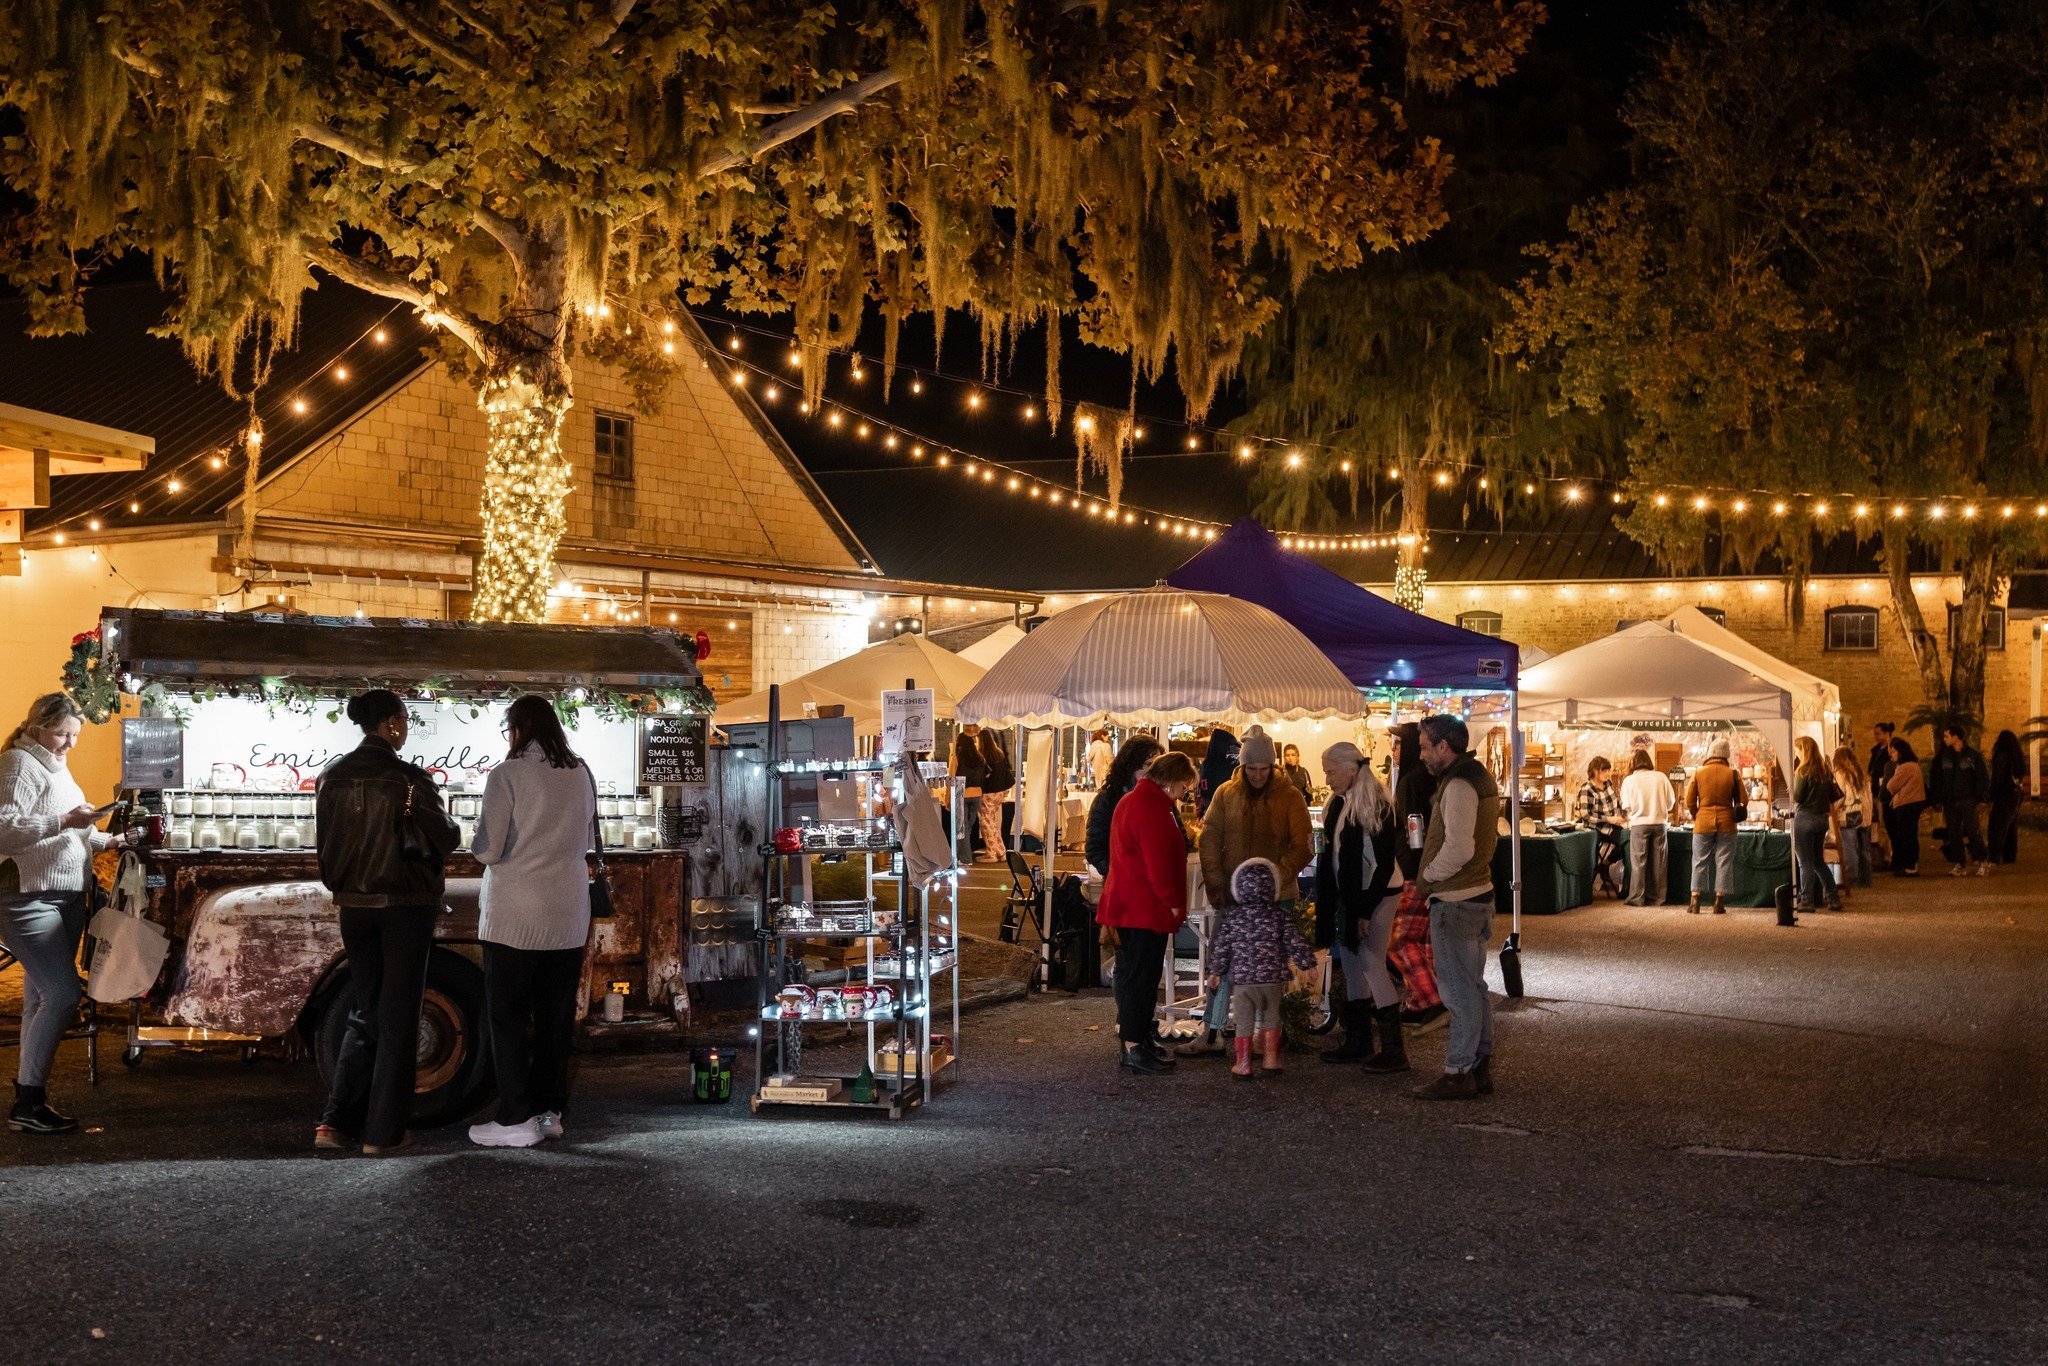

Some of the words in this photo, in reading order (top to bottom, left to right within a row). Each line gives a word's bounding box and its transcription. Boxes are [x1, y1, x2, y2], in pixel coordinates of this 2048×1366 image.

[887, 697, 929, 706] FRESHIES
[669, 719, 701, 727] GRN
[664, 726, 682, 734] SOY
[650, 736, 693, 744] NONTOXIC
[395, 745, 501, 769] ndle
[648, 749, 678, 757] SMALL
[681, 749, 695, 757] $16
[648, 758, 679, 766] LARGE
[685, 758, 695, 766] 24
[646, 766, 673, 774] MELTS
[674, 766, 681, 774] &
[642, 773, 682, 782] FRESHIES
